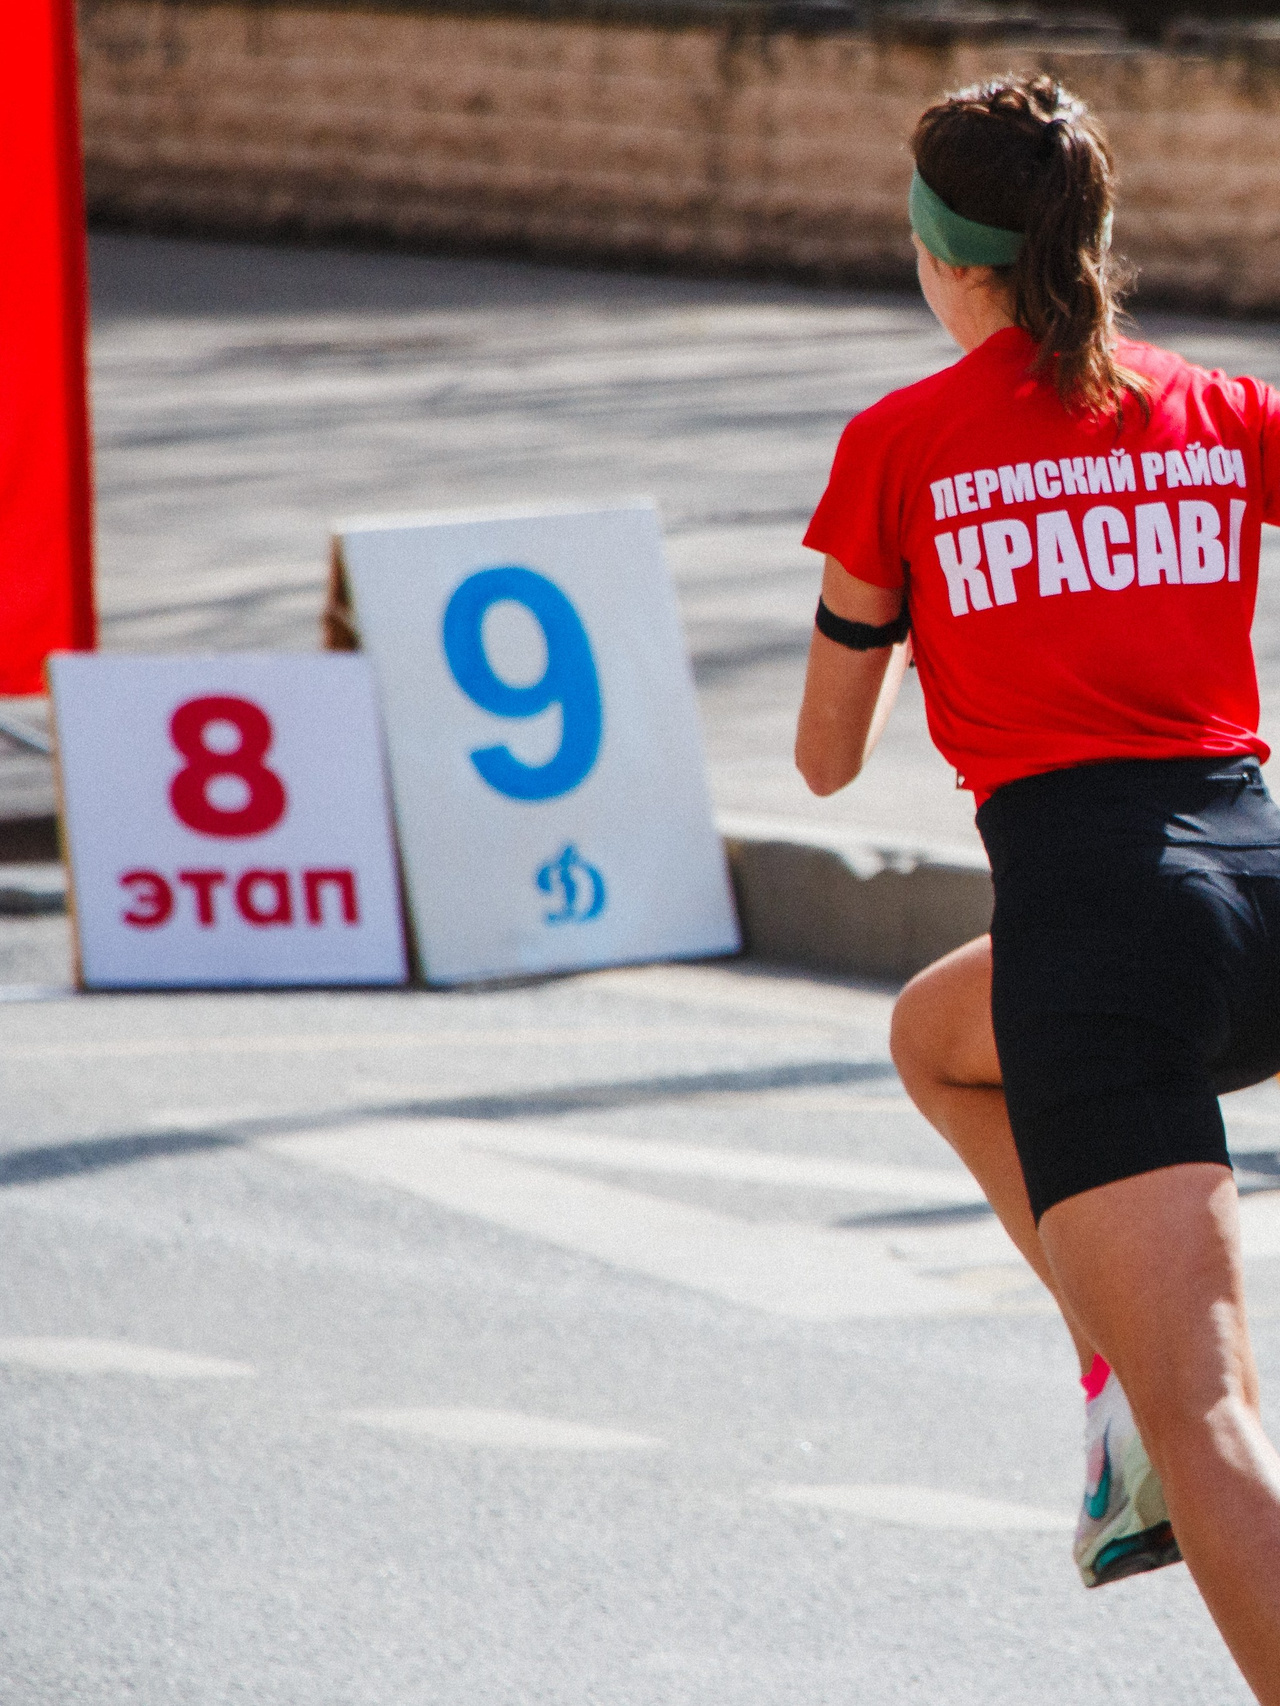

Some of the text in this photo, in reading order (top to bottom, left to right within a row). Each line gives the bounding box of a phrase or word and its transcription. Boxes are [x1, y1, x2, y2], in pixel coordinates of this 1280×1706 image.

[929, 448, 1138, 521] ПЕРМСКИЙ
[439, 561, 607, 806] 9
[168, 695, 287, 839] 8
[120, 869, 361, 929] этап
